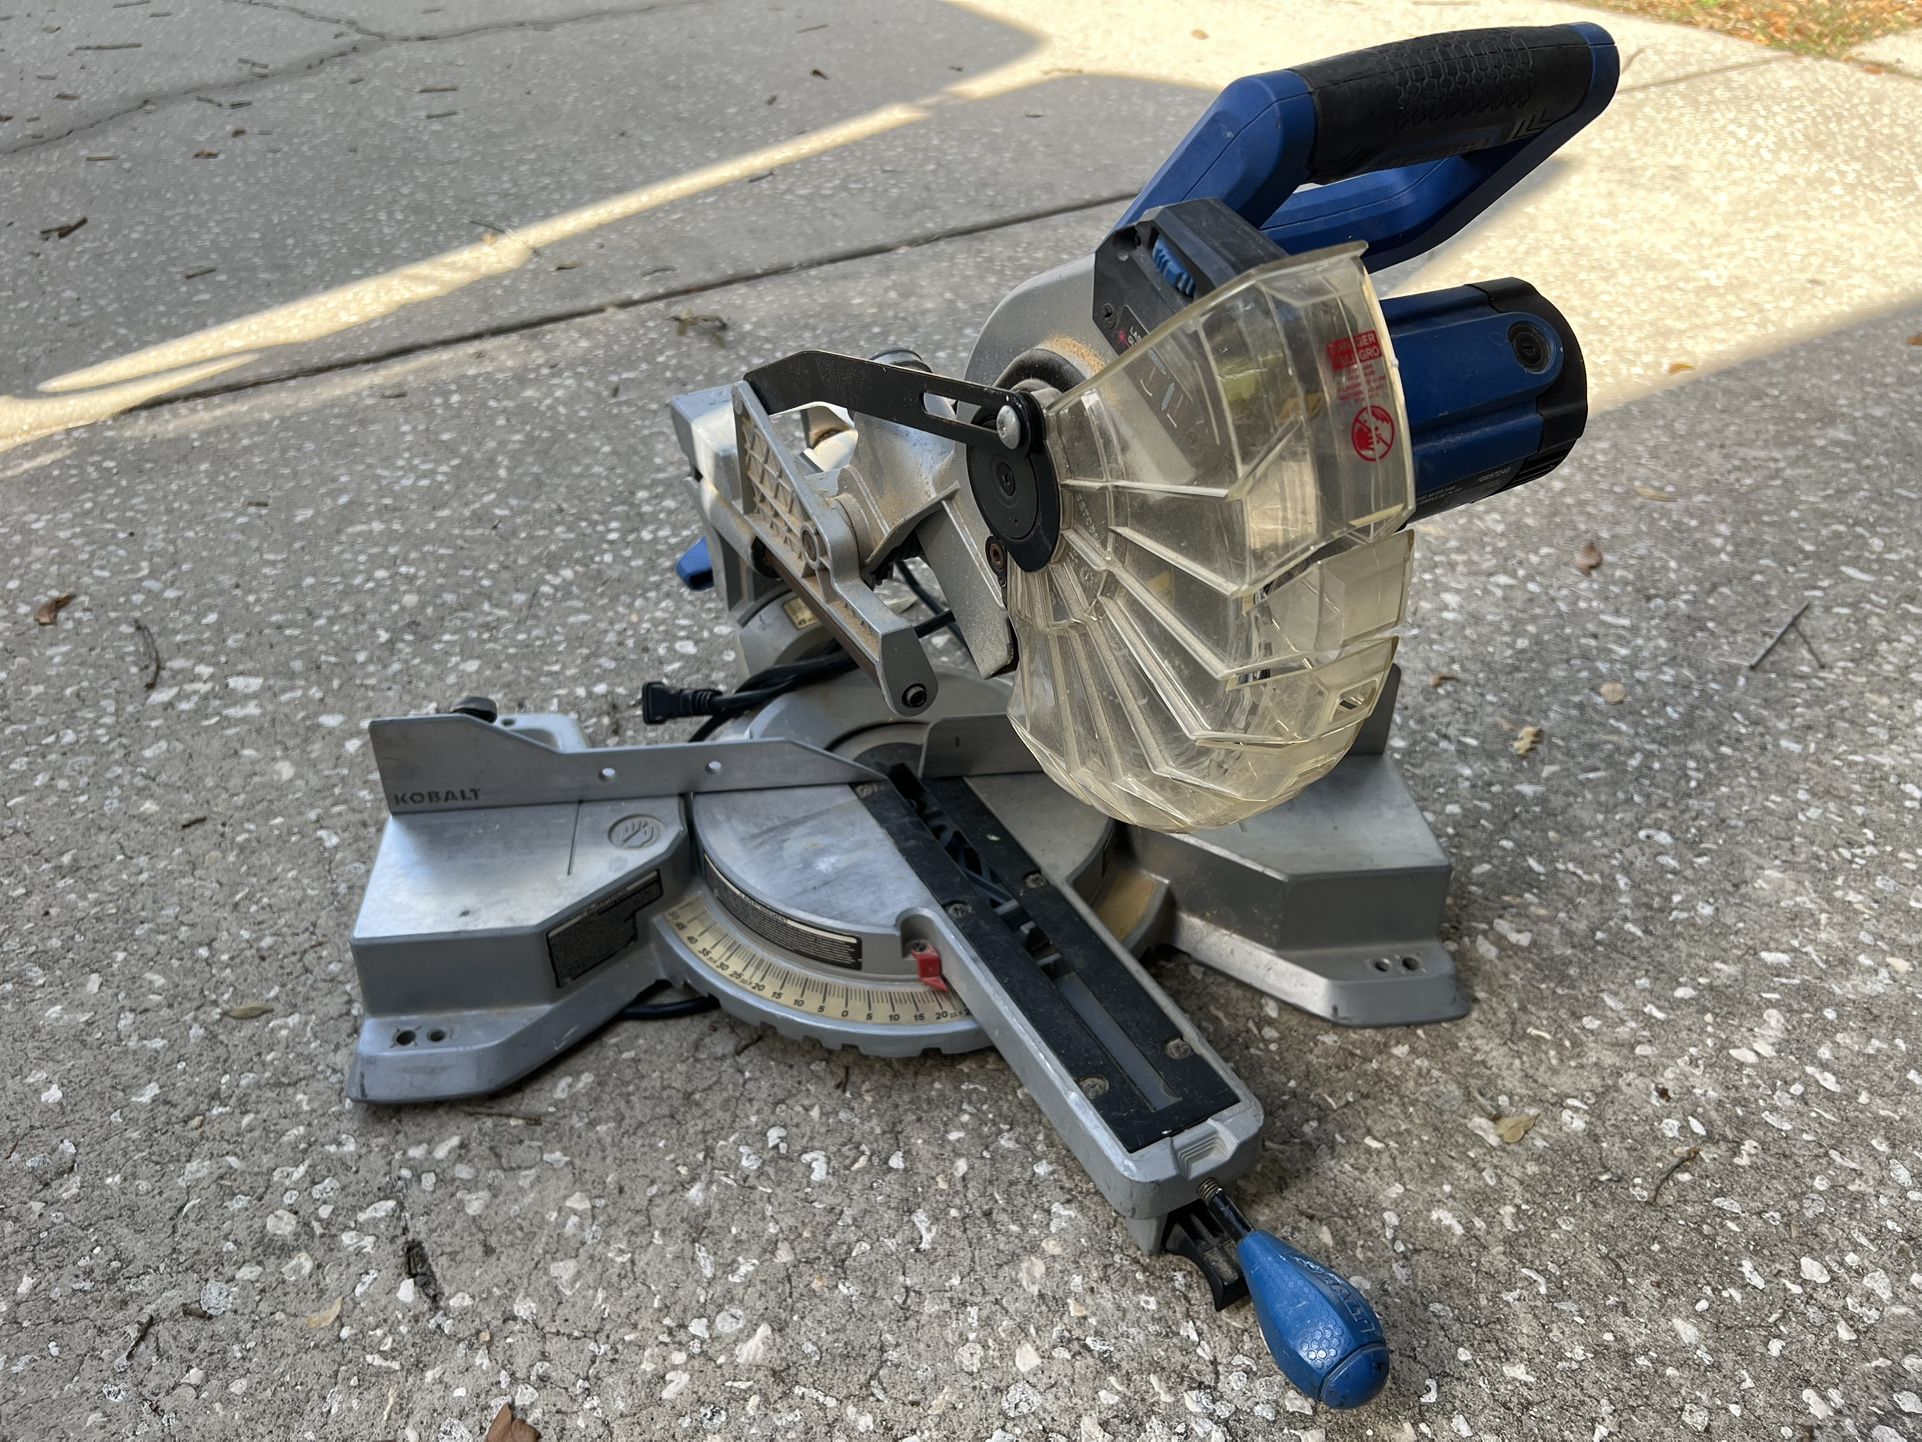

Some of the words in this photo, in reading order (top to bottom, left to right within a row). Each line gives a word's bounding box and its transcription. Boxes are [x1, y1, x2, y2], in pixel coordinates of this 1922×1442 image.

[393, 788, 481, 806] KOBALT
[715, 962, 729, 971] 30
[729, 971, 743, 980] 25
[751, 982, 766, 992] 20
[771, 991, 783, 1000] 15
[793, 998, 805, 1007] 10
[817, 1005, 826, 1013] 5
[841, 1010, 849, 1018] 0
[865, 1013, 873, 1021] 5
[888, 1013, 900, 1022] 10
[913, 1013, 925, 1022] 15
[935, 1010, 948, 1020] 20
